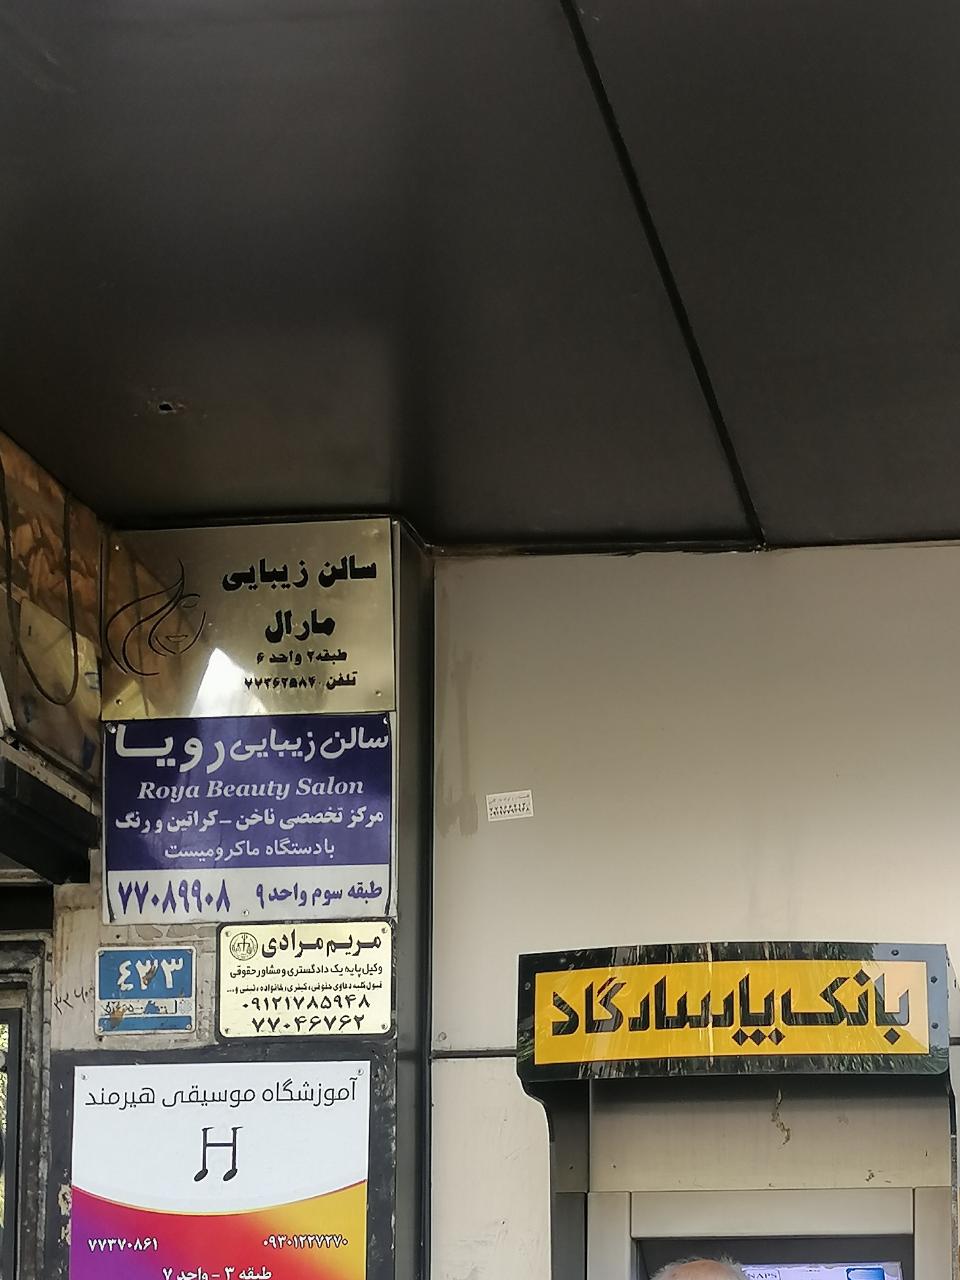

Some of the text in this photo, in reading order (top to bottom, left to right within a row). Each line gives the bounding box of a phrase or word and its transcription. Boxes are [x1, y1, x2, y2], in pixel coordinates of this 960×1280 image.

[222, 555, 377, 591] سالن زیبایی
[265, 609, 336, 643] مارال
[269, 650, 302, 665] واحد
[325, 671, 358, 690] تلفن
[115, 723, 389, 774] سالن زیبایی رویا
[136, 776, 364, 802] Roya Beauty Salon
[115, 810, 150, 834] رنگ
[154, 820, 163, 833] و
[167, 809, 219, 832] کراتین
[235, 808, 275, 830] ناخن
[279, 807, 343, 830] تخصصی
[347, 806, 384, 828] مرکز
[164, 839, 260, 862] ماکرومیست
[265, 838, 320, 857] دستگاه
[118, 879, 231, 915] ۷۷۰۸۹۹۰۸
[256, 881, 383, 910] طبقه سوم واحد ۹
[261, 929, 382, 958] مریم مرادی
[229, 965, 257, 978] حقوقی
[256, 964, 281, 978] مشاور
[287, 964, 329, 977] دادگستری
[330, 965, 344, 976] یک
[344, 965, 362, 977] پایه
[362, 963, 383, 975] وکیل
[242, 994, 371, 1011] ۰۹۱۲۱۷۸۵۹۴۸
[551, 968, 911, 1047] بانک پاسارگاد
[251, 1014, 365, 1033] ۷۷۰۴۶۷۶۲
[85, 1077, 358, 1110] آموزشگاه موسیقی هیرمند
[88, 1237, 158, 1252] ۷۷۳۷۰۸۶۱
[225, 1267, 235, 1280] ۳
